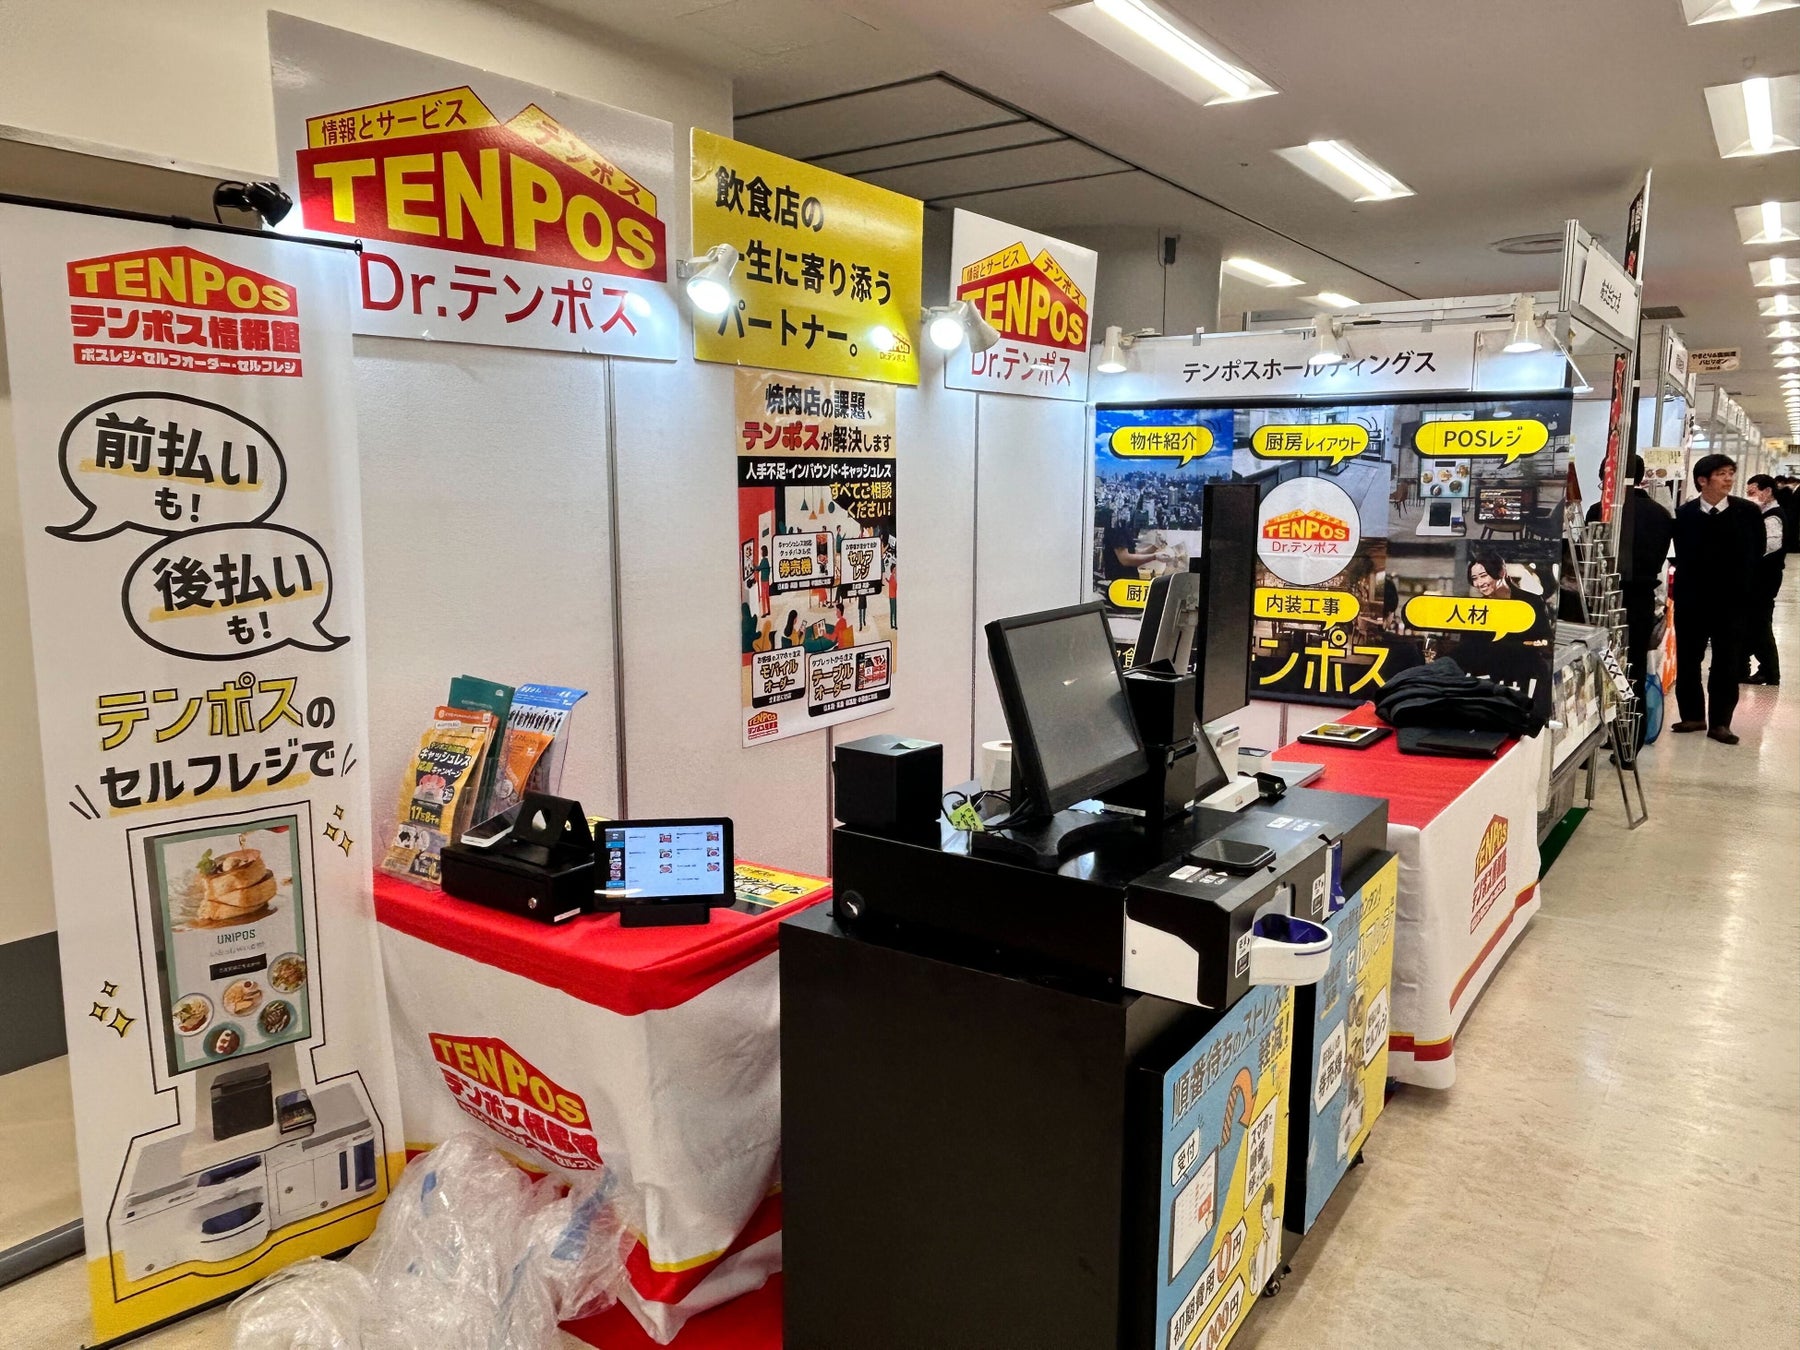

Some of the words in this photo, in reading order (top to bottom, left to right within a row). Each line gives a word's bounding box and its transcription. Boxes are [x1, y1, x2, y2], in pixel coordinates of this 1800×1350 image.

[322, 99, 467, 146] 情報とサービス
[535, 121, 643, 206] テンポス
[313, 148, 656, 270] TENPOS
[715, 166, 824, 232] 飲食店の
[737, 240, 891, 305] 生に寄り添う
[966, 249, 1020, 281] 情報とサービス
[1042, 257, 1081, 305] テンポス
[74, 256, 291, 311] TENPOS
[360, 253, 638, 337] Dr.テンポス
[71, 305, 301, 353] テンポス情報館
[971, 347, 1071, 386] Dr.テンポス
[766, 383, 872, 419] 焼肉店の課題、
[95, 412, 258, 485] 前払い
[743, 421, 892, 453] テンポスが解決します
[1130, 432, 1197, 450] 物件紹介
[1265, 431, 1362, 452] 厨房レイアウト
[1443, 424, 1523, 448] POSレジ
[746, 462, 892, 480] 人手不足・インバウンド・キャッシュレス
[830, 482, 892, 499] すべてご相談
[1266, 519, 1346, 539] TENPOS
[1272, 541, 1339, 554] Dr.テンポス
[154, 553, 313, 611] 後払い
[779, 556, 812, 578] 券売機
[1126, 584, 1151, 601] 厨
[1266, 595, 1340, 615] 内装工事
[1446, 604, 1489, 625] 人材
[760, 659, 798, 679] モバイル
[812, 663, 854, 687] テーブル
[1252, 629, 1390, 694] ンポス
[764, 676, 795, 693] オーダー
[815, 680, 851, 700] オーダー
[97, 671, 336, 751] テンポスの
[100, 738, 335, 807] セルフレジで
[420, 748, 472, 767] キャッシュレス
[1476, 821, 1508, 877] TENPOS
[216, 928, 256, 945] UNIPOS
[434, 1038, 585, 1124] TENPOS
[1177, 1137, 1195, 1175] 受付
